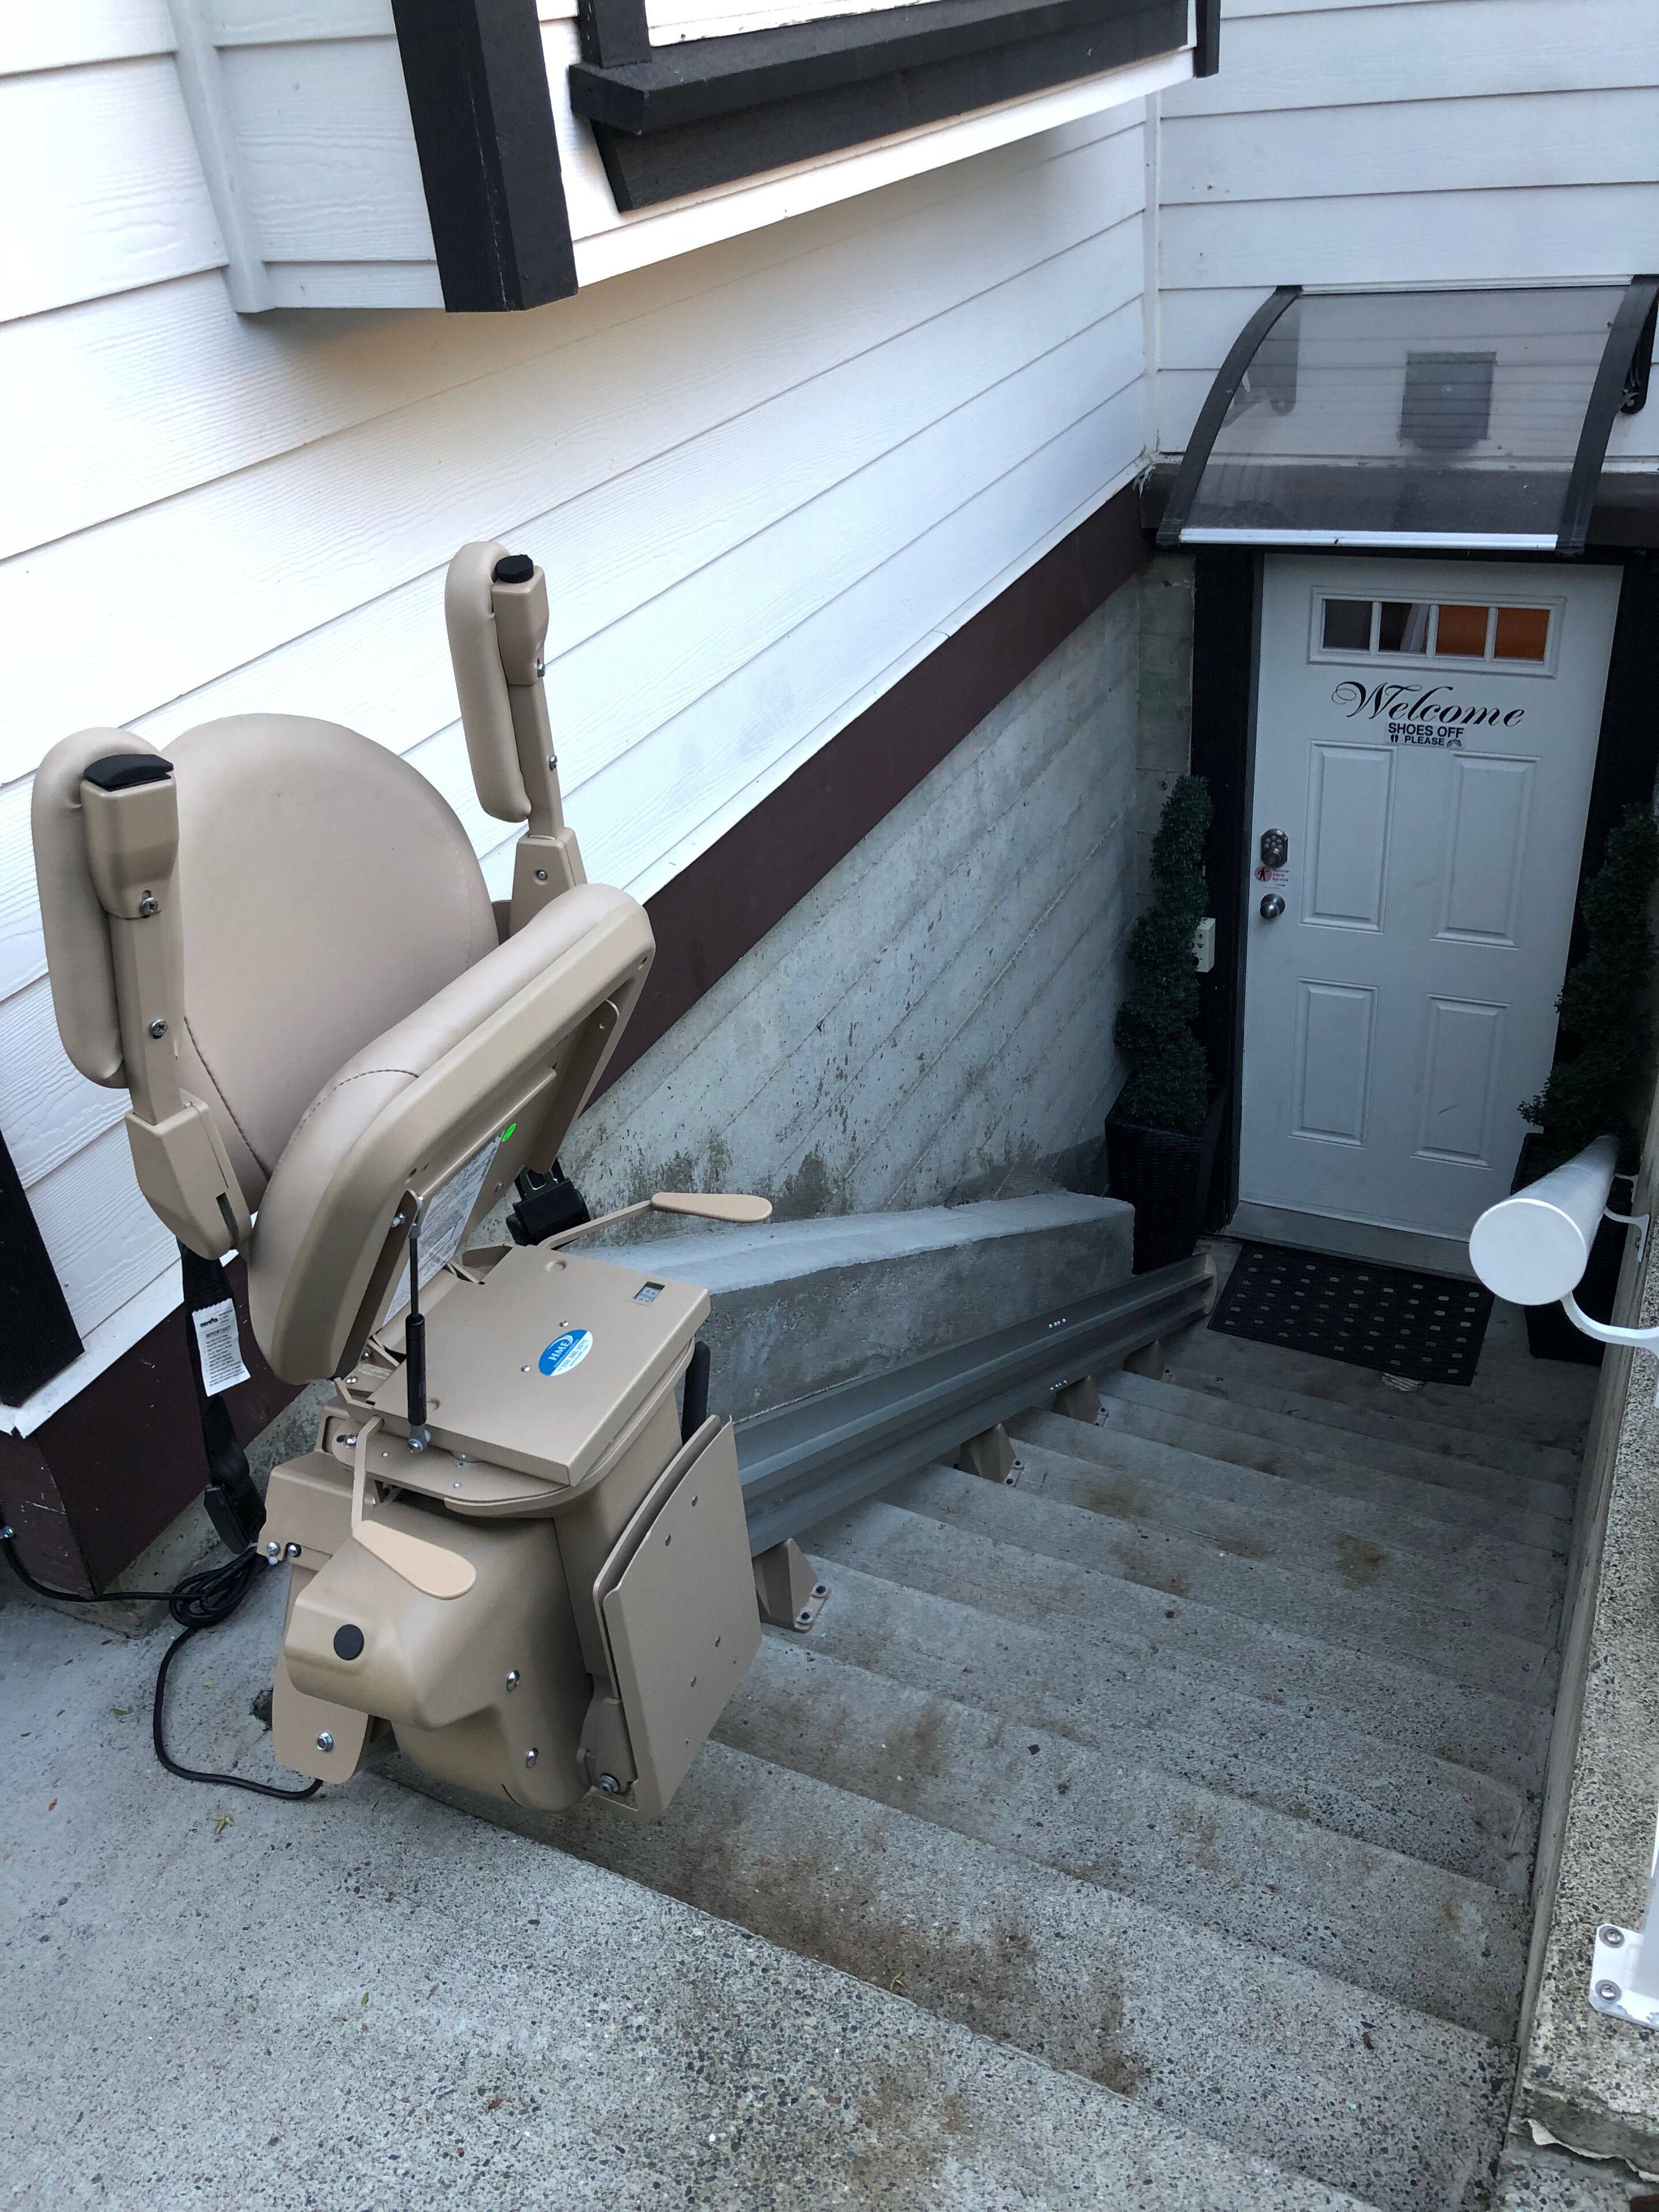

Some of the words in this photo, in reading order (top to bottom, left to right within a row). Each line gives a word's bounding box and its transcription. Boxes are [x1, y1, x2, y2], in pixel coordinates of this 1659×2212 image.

[1331, 681, 1525, 728] Welcome
[1388, 722, 1433, 737] SHOES
[1437, 726, 1464, 738] OFF
[1404, 736, 1445, 746] PLEASE
[548, 1341, 570, 1361] HME
